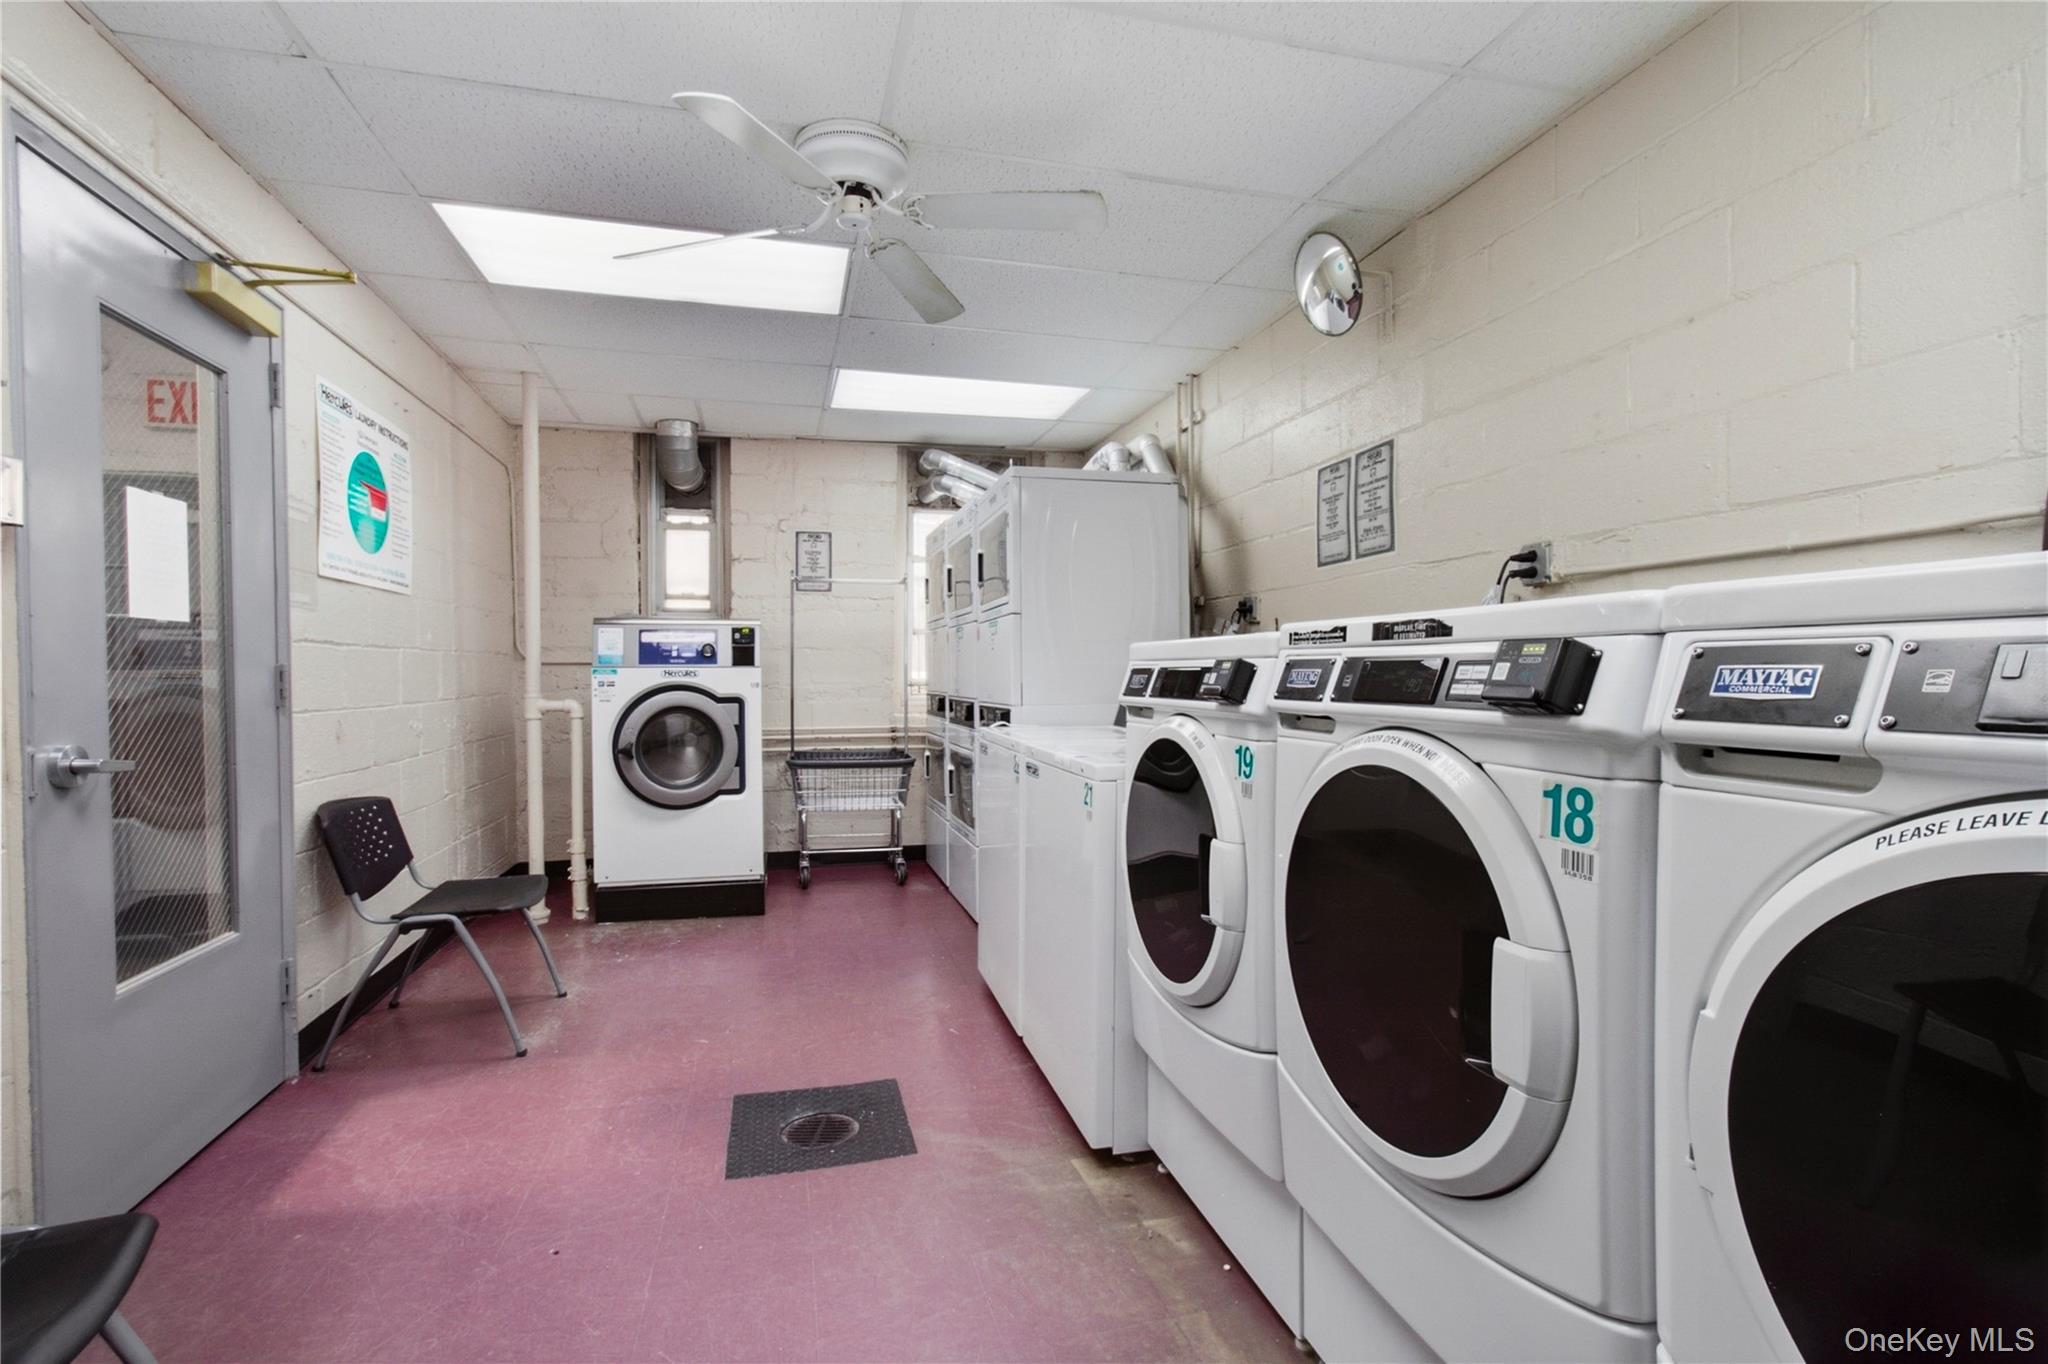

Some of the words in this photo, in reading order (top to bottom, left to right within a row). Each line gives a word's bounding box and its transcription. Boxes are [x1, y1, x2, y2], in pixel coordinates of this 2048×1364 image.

[147, 379, 198, 424] EXI
[1717, 668, 1814, 687] MAYTAG
[1728, 685, 1792, 694] COMMERCIAL
[1235, 745, 1254, 779] 19
[1543, 784, 1594, 845] 18
[1875, 820, 1950, 850] PLEASE
[1956, 811, 2033, 832] LEAVE
